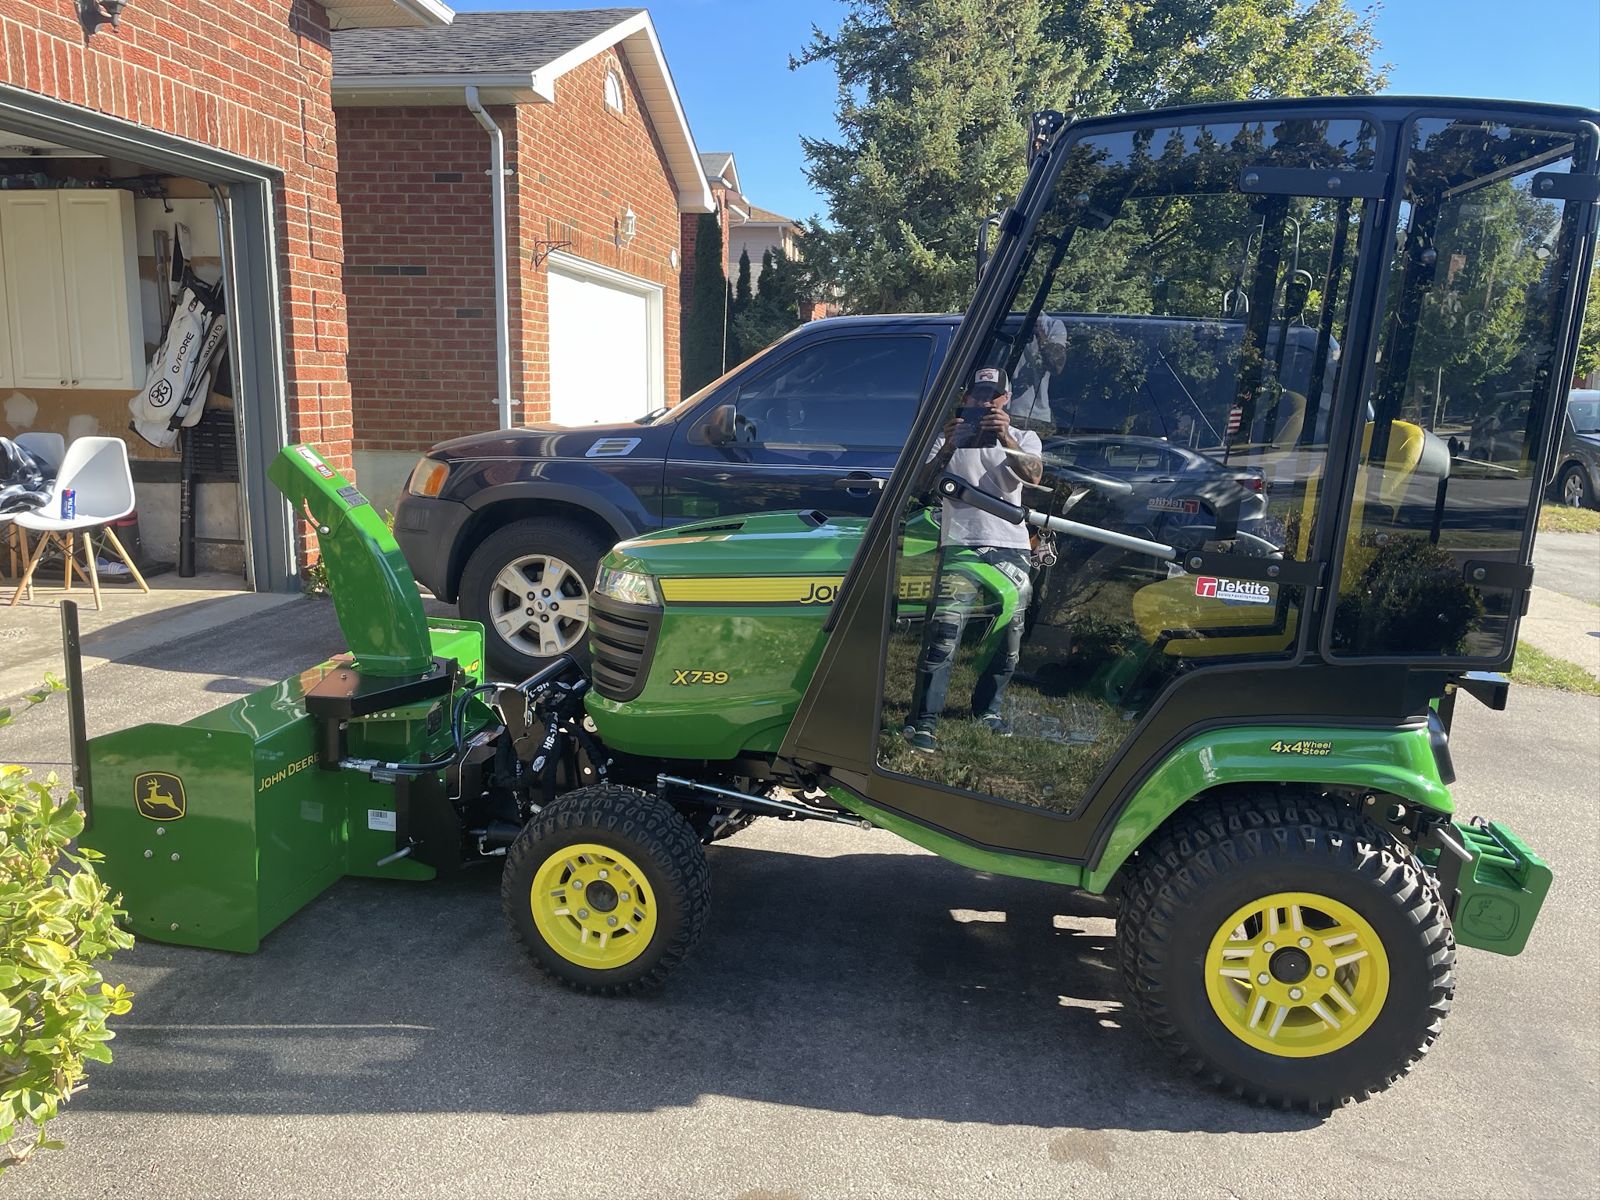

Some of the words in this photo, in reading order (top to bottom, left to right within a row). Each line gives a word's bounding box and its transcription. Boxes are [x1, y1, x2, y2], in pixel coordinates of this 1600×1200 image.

[171, 331, 195, 374] G/FORE
[800, 582, 841, 602] JO
[1218, 579, 1270, 595] Tektite
[671, 669, 729, 685] X739
[1270, 740, 1303, 754] 4x4
[1302, 741, 1332, 749] Wheel
[258, 768, 287, 792] JOHN
